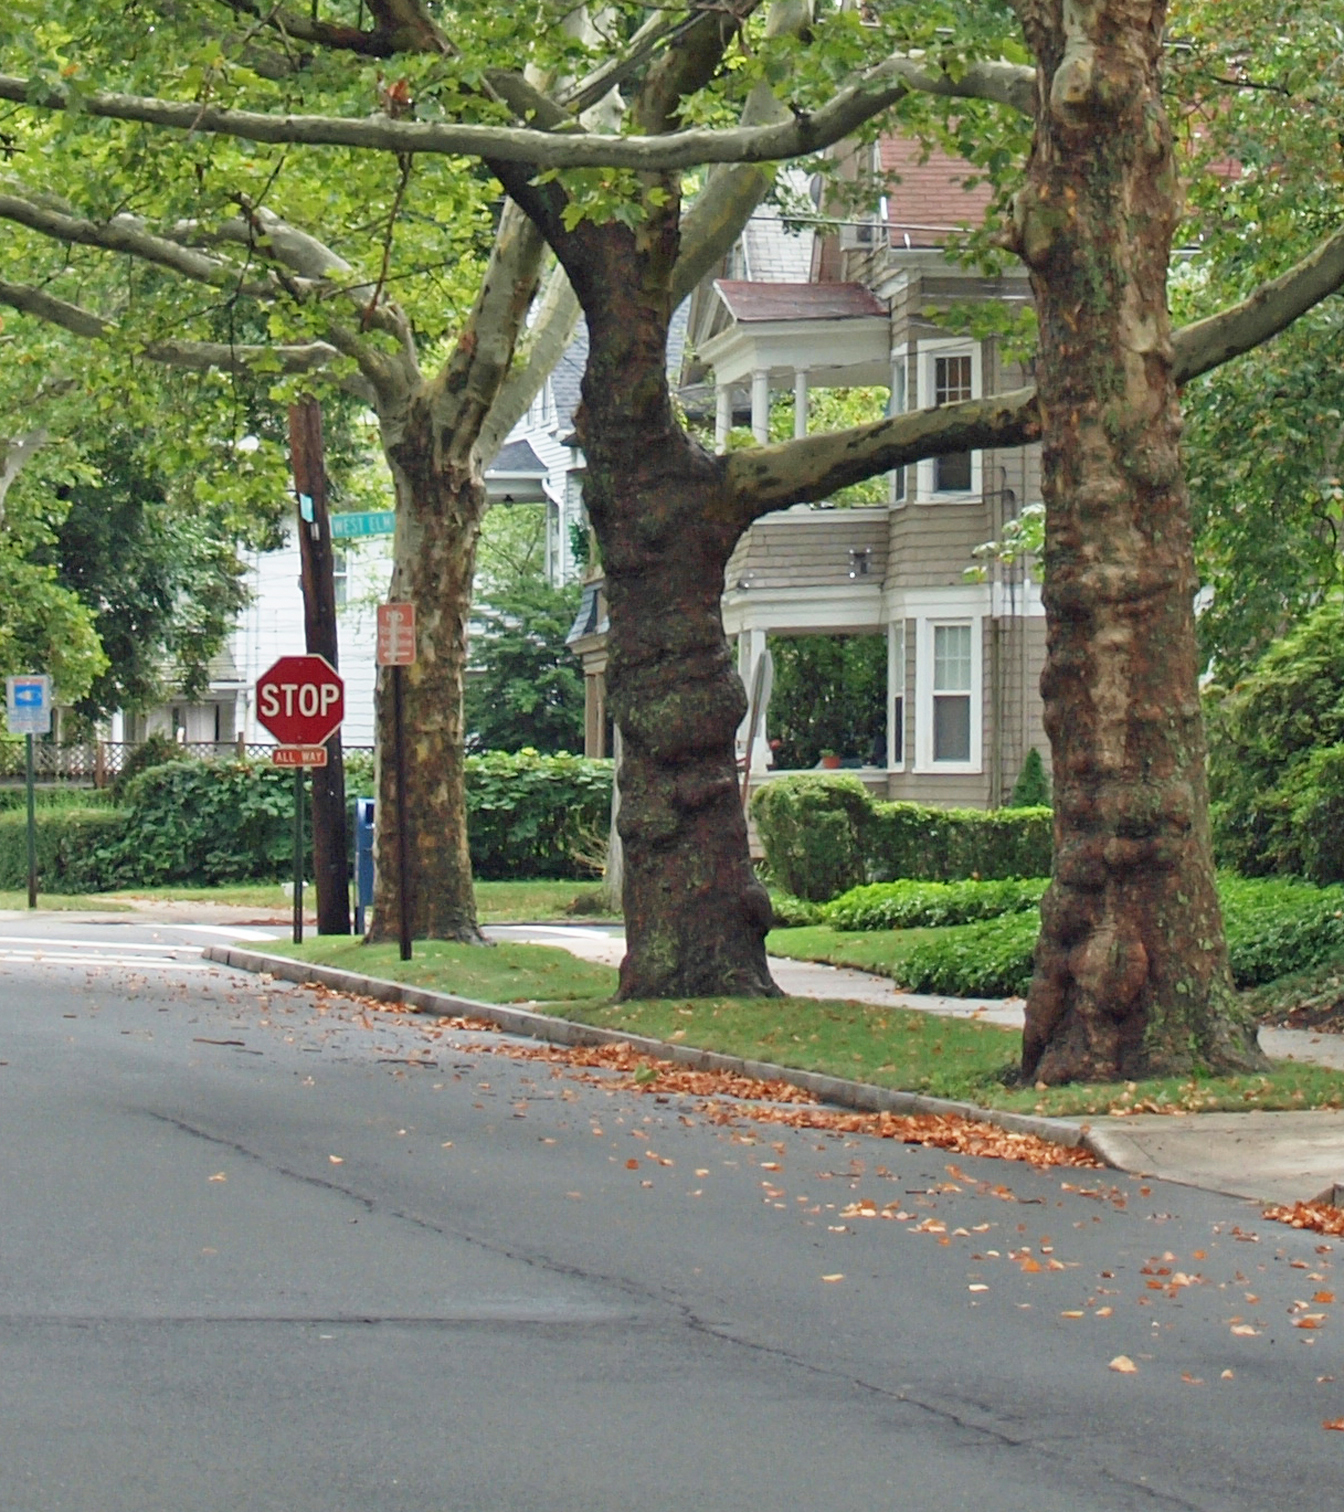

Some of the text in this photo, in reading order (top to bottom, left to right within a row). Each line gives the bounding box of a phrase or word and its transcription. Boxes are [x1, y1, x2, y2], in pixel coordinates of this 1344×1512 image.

[334, 517, 363, 535] WEST
[261, 683, 340, 717] STOP
[276, 751, 323, 763] ALL WAY
